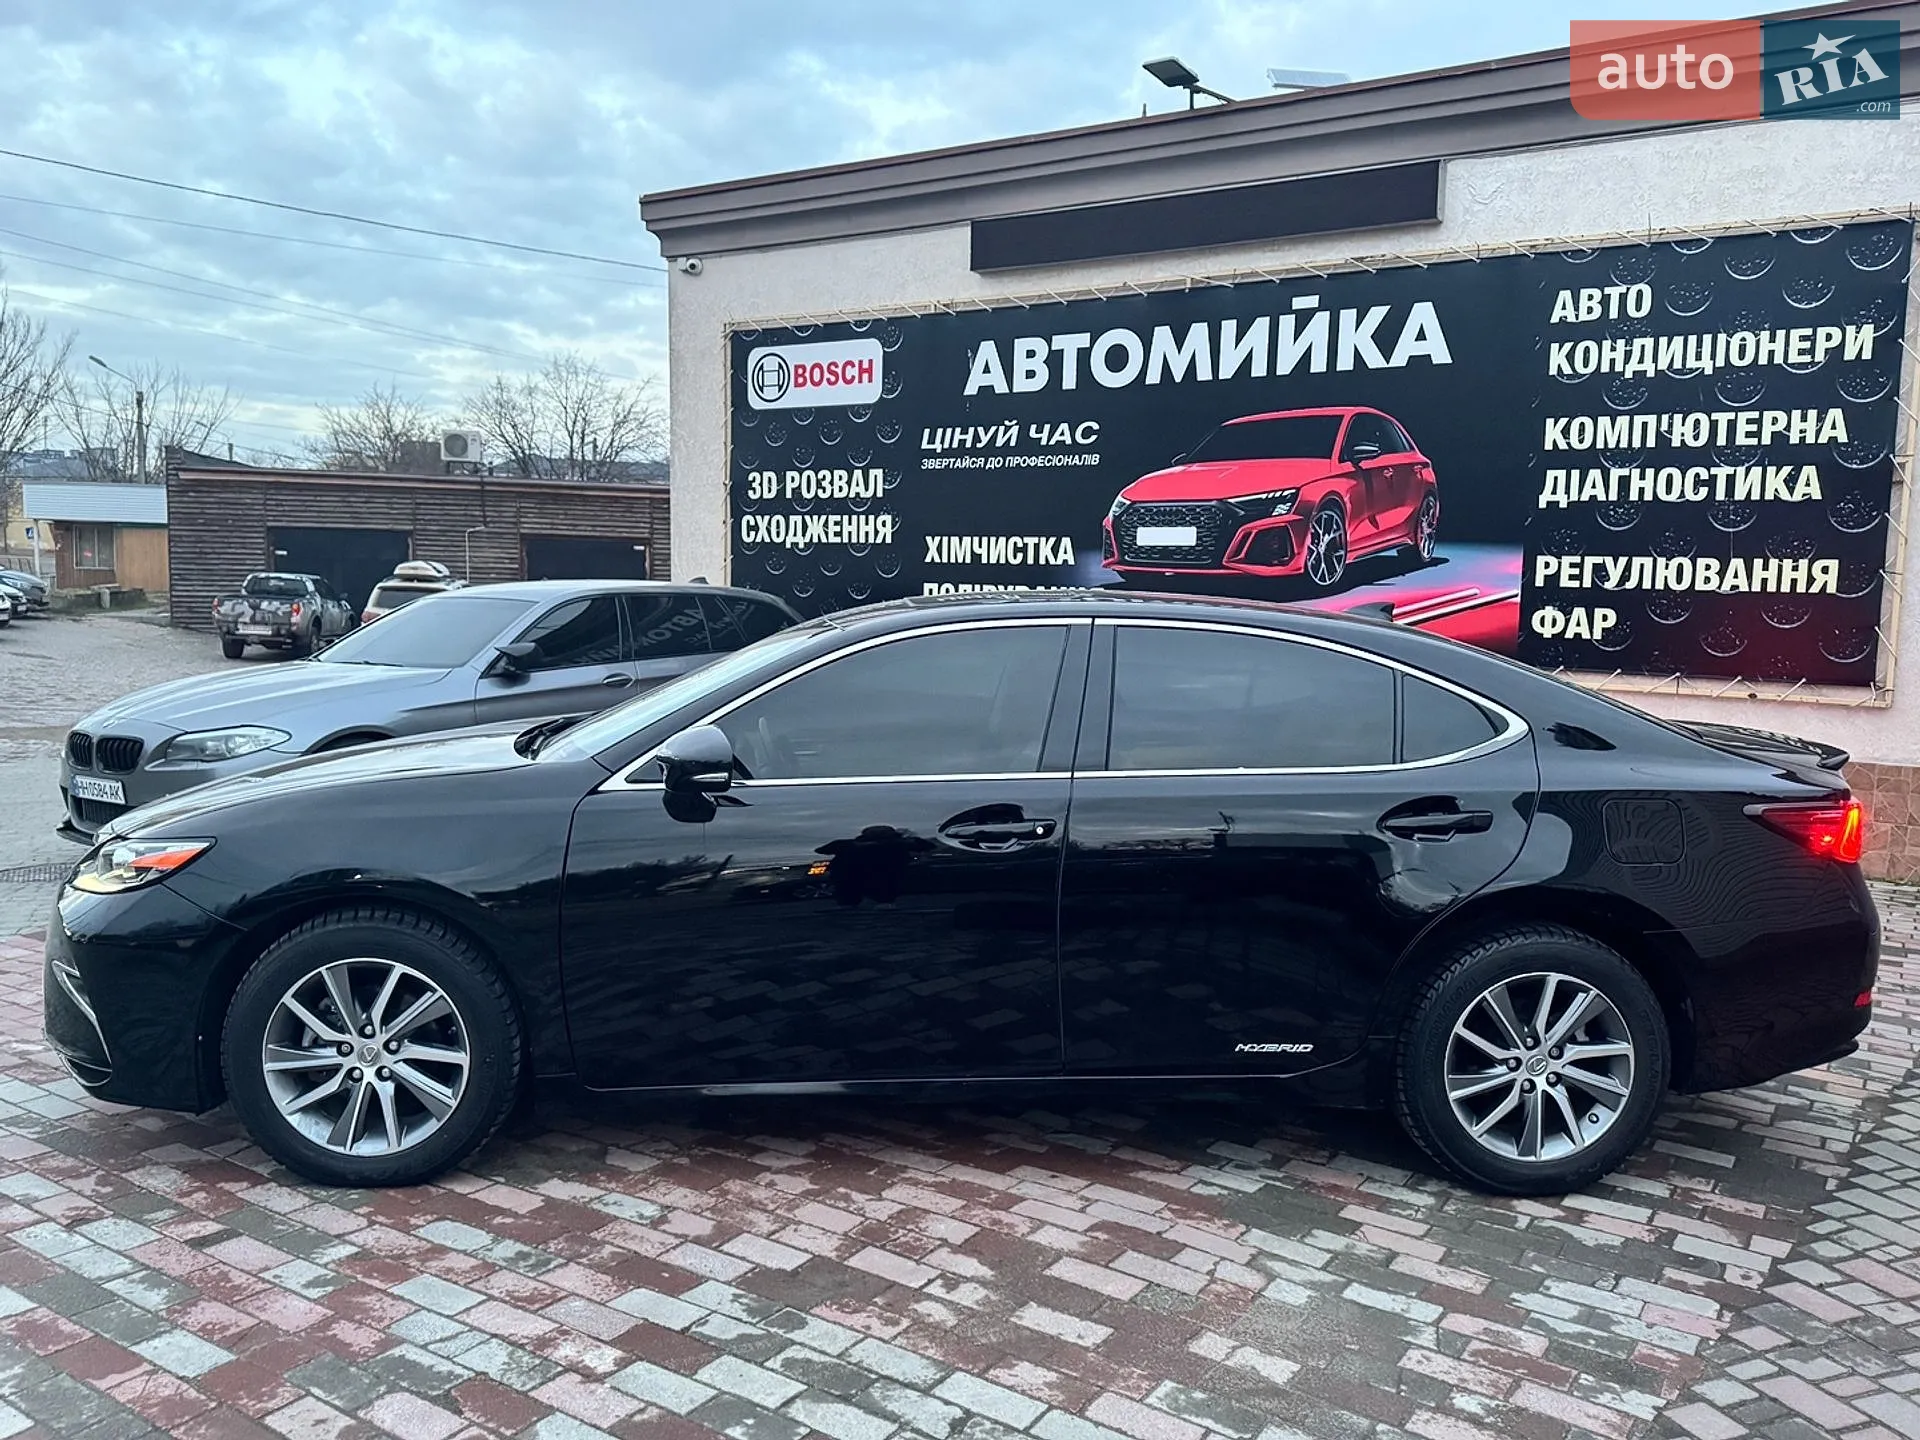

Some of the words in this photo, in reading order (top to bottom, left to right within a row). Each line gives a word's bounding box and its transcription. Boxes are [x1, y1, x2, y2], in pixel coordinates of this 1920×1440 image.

[1549, 283, 1653, 324] АВТО
[962, 294, 1454, 396] АВТОМИЙКА
[1548, 324, 1876, 379] КОНДИЦІОНЕРИ
[793, 358, 874, 388] BOSCH
[920, 419, 1020, 453] ЦІНУЙ
[1029, 421, 1101, 446] ЧАС
[1543, 407, 1849, 451] КОМП'ЮТЕРНА
[920, 456, 985, 470] ЗВЕРТАЙСЯ
[985, 456, 1004, 470] ДО
[1005, 453, 1101, 468] ПРОФЕСІОНАЛІВ
[747, 471, 778, 500] 3D
[785, 468, 884, 499] РОЗВАЛ
[1538, 465, 1823, 509] ДІАГНОСТИКА
[741, 514, 892, 549] СХОДЖЕННЯ
[924, 535, 1076, 565] ХІМЧИСТКА
[1534, 554, 1840, 595] РЕГУЛЮВАННЯ
[1531, 607, 1618, 640] ФАР
[1234, 1043, 1314, 1053] HYBRID
